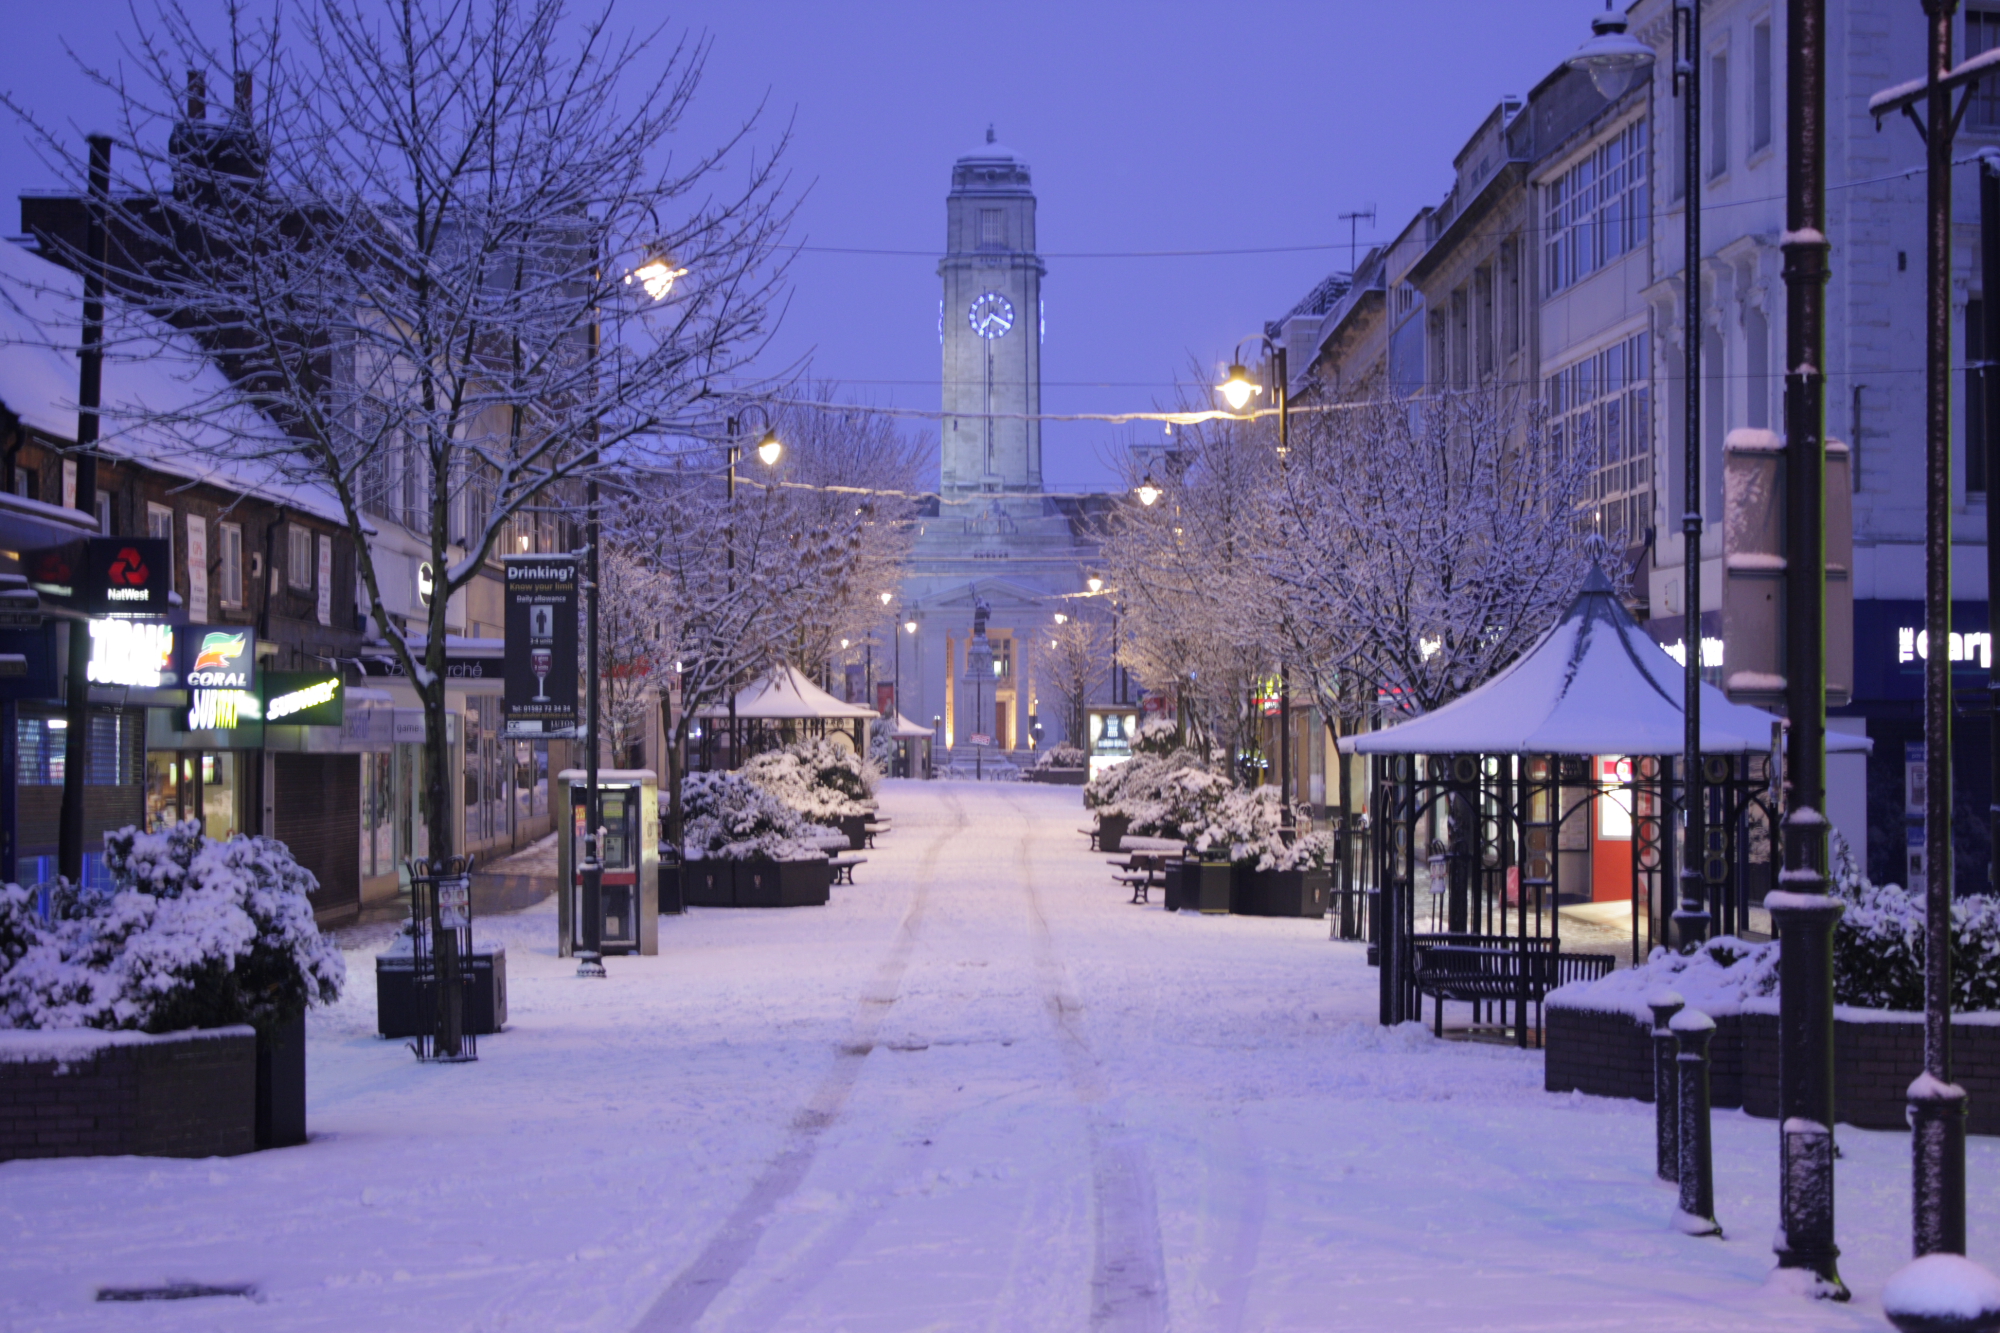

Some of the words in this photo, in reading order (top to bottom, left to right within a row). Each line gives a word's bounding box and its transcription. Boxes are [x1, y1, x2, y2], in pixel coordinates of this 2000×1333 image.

[508, 565, 575, 582] Drinking?
[107, 588, 149, 601] NatWest
[509, 583, 533, 592] Know
[534, 584, 553, 594] your
[555, 582, 574, 592] limit
[516, 595, 533, 605] Daily
[534, 595, 567, 604] allowance
[187, 672, 247, 687] CORAL
[266, 677, 339, 721] SUBWAY
